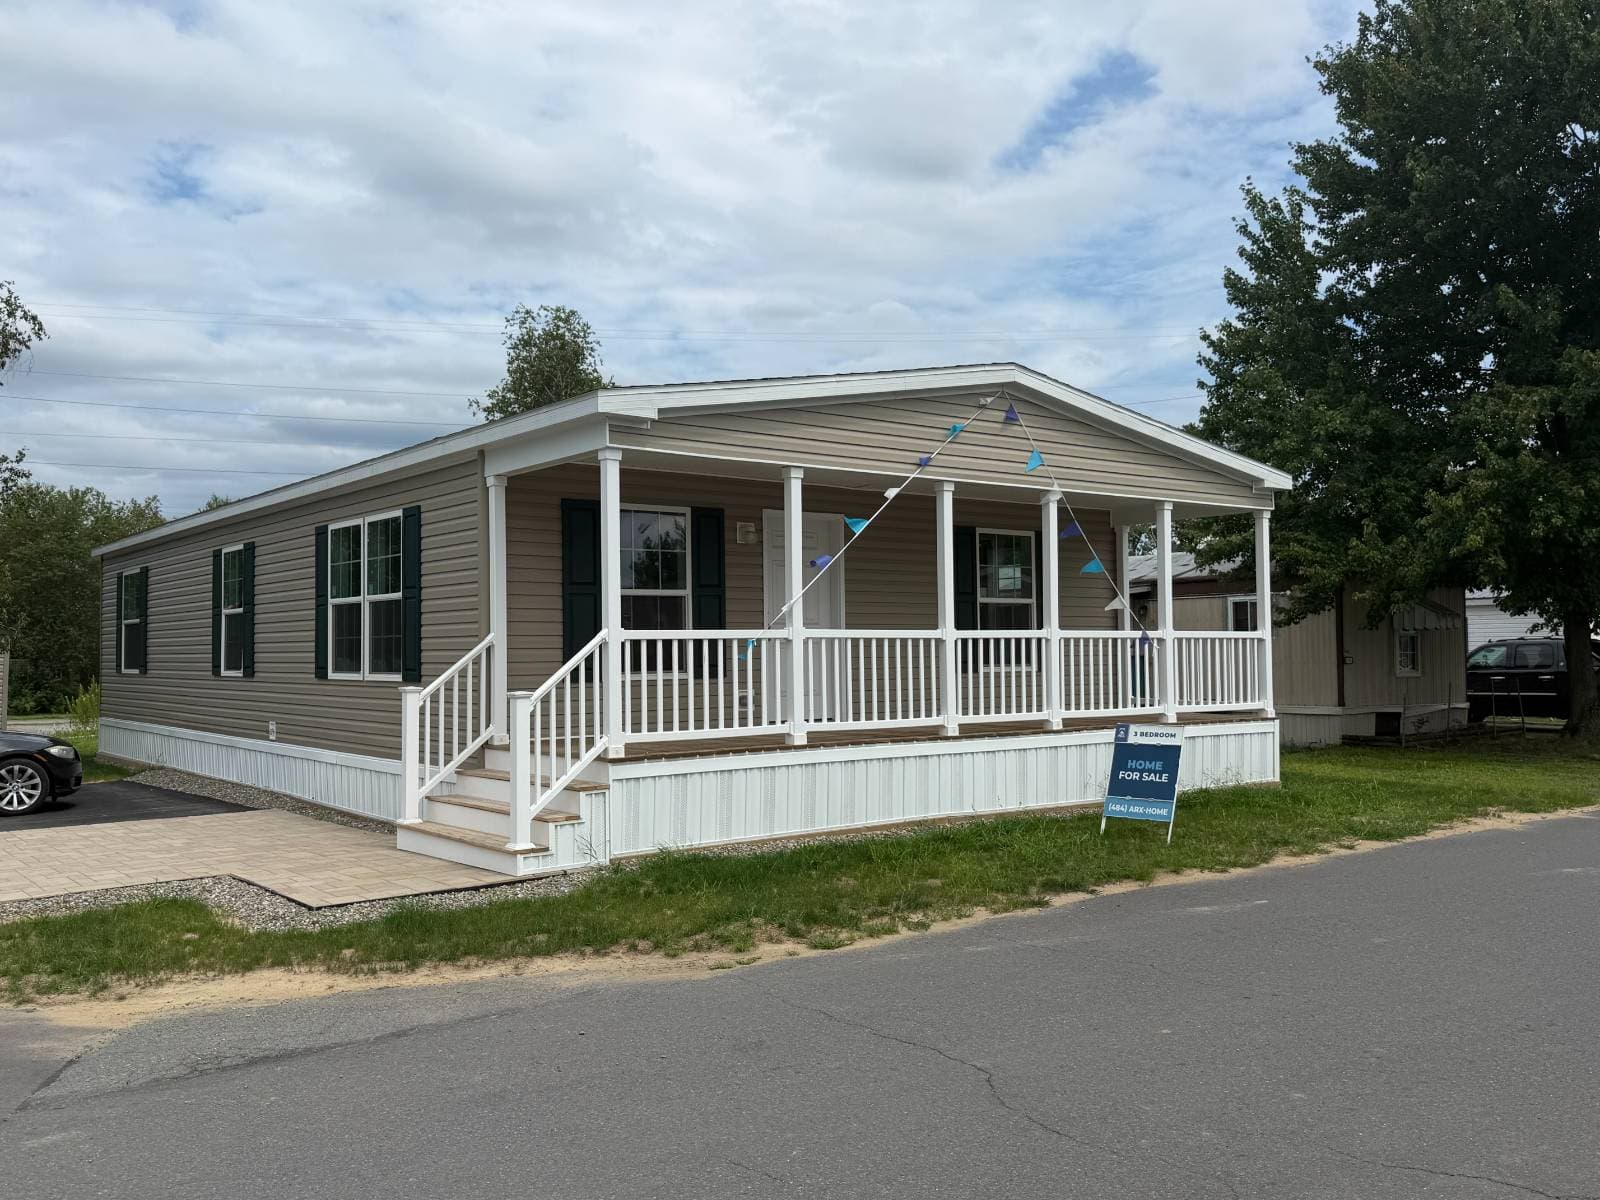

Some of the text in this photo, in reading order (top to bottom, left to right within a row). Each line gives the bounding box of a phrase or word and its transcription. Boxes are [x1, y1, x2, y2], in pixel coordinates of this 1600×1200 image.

[1127, 759, 1163, 770] HOME
[1118, 771, 1169, 782] FOR SALE
[1108, 803, 1128, 813] (484)
